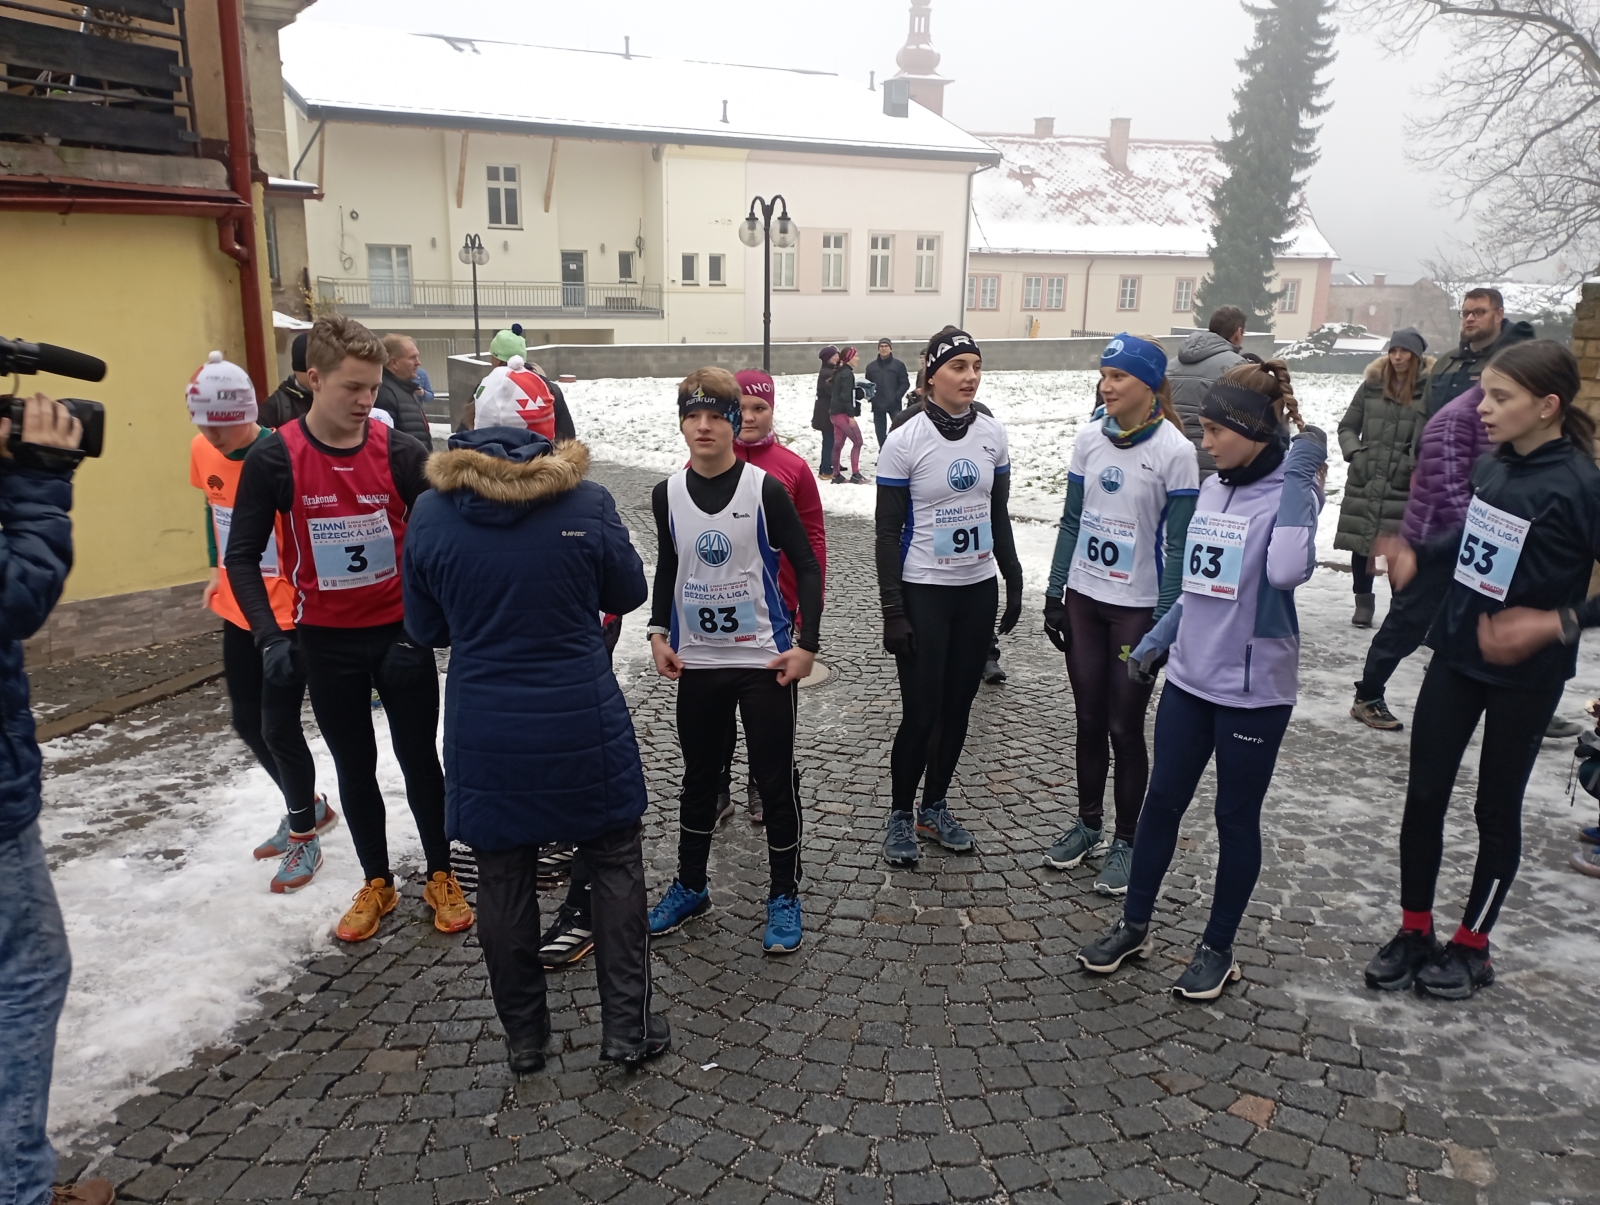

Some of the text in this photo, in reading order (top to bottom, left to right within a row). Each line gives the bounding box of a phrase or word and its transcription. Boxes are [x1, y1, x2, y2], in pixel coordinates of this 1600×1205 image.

[207, 410, 245, 422] MARATON
[302, 494, 338, 506] Krakonoš
[356, 494, 390, 503] MARATON
[935, 506, 963, 516] ZIMNÍ
[935, 515, 974, 524] BĚŽECKÁ
[975, 511, 989, 519] LIGA
[311, 521, 346, 531] ZIMNÍ
[313, 530, 364, 540] BĚŽECKÁ
[366, 525, 389, 535] LIGA
[1113, 528, 1134, 538] LIGA
[1220, 530, 1242, 541] LIGA
[1497, 529, 1520, 544] LIGA
[952, 526, 979, 553] 91
[1087, 536, 1119, 566] 60
[1460, 533, 1499, 575] 53
[344, 545, 368, 573] 3
[1190, 544, 1224, 578] 63
[684, 582, 709, 593] ZIMNÍ
[684, 591, 725, 601] BĚŽECKÁ
[727, 590, 750, 599] LIGA
[698, 606, 739, 633] 83
[1233, 732, 1258, 743] CRAFT
